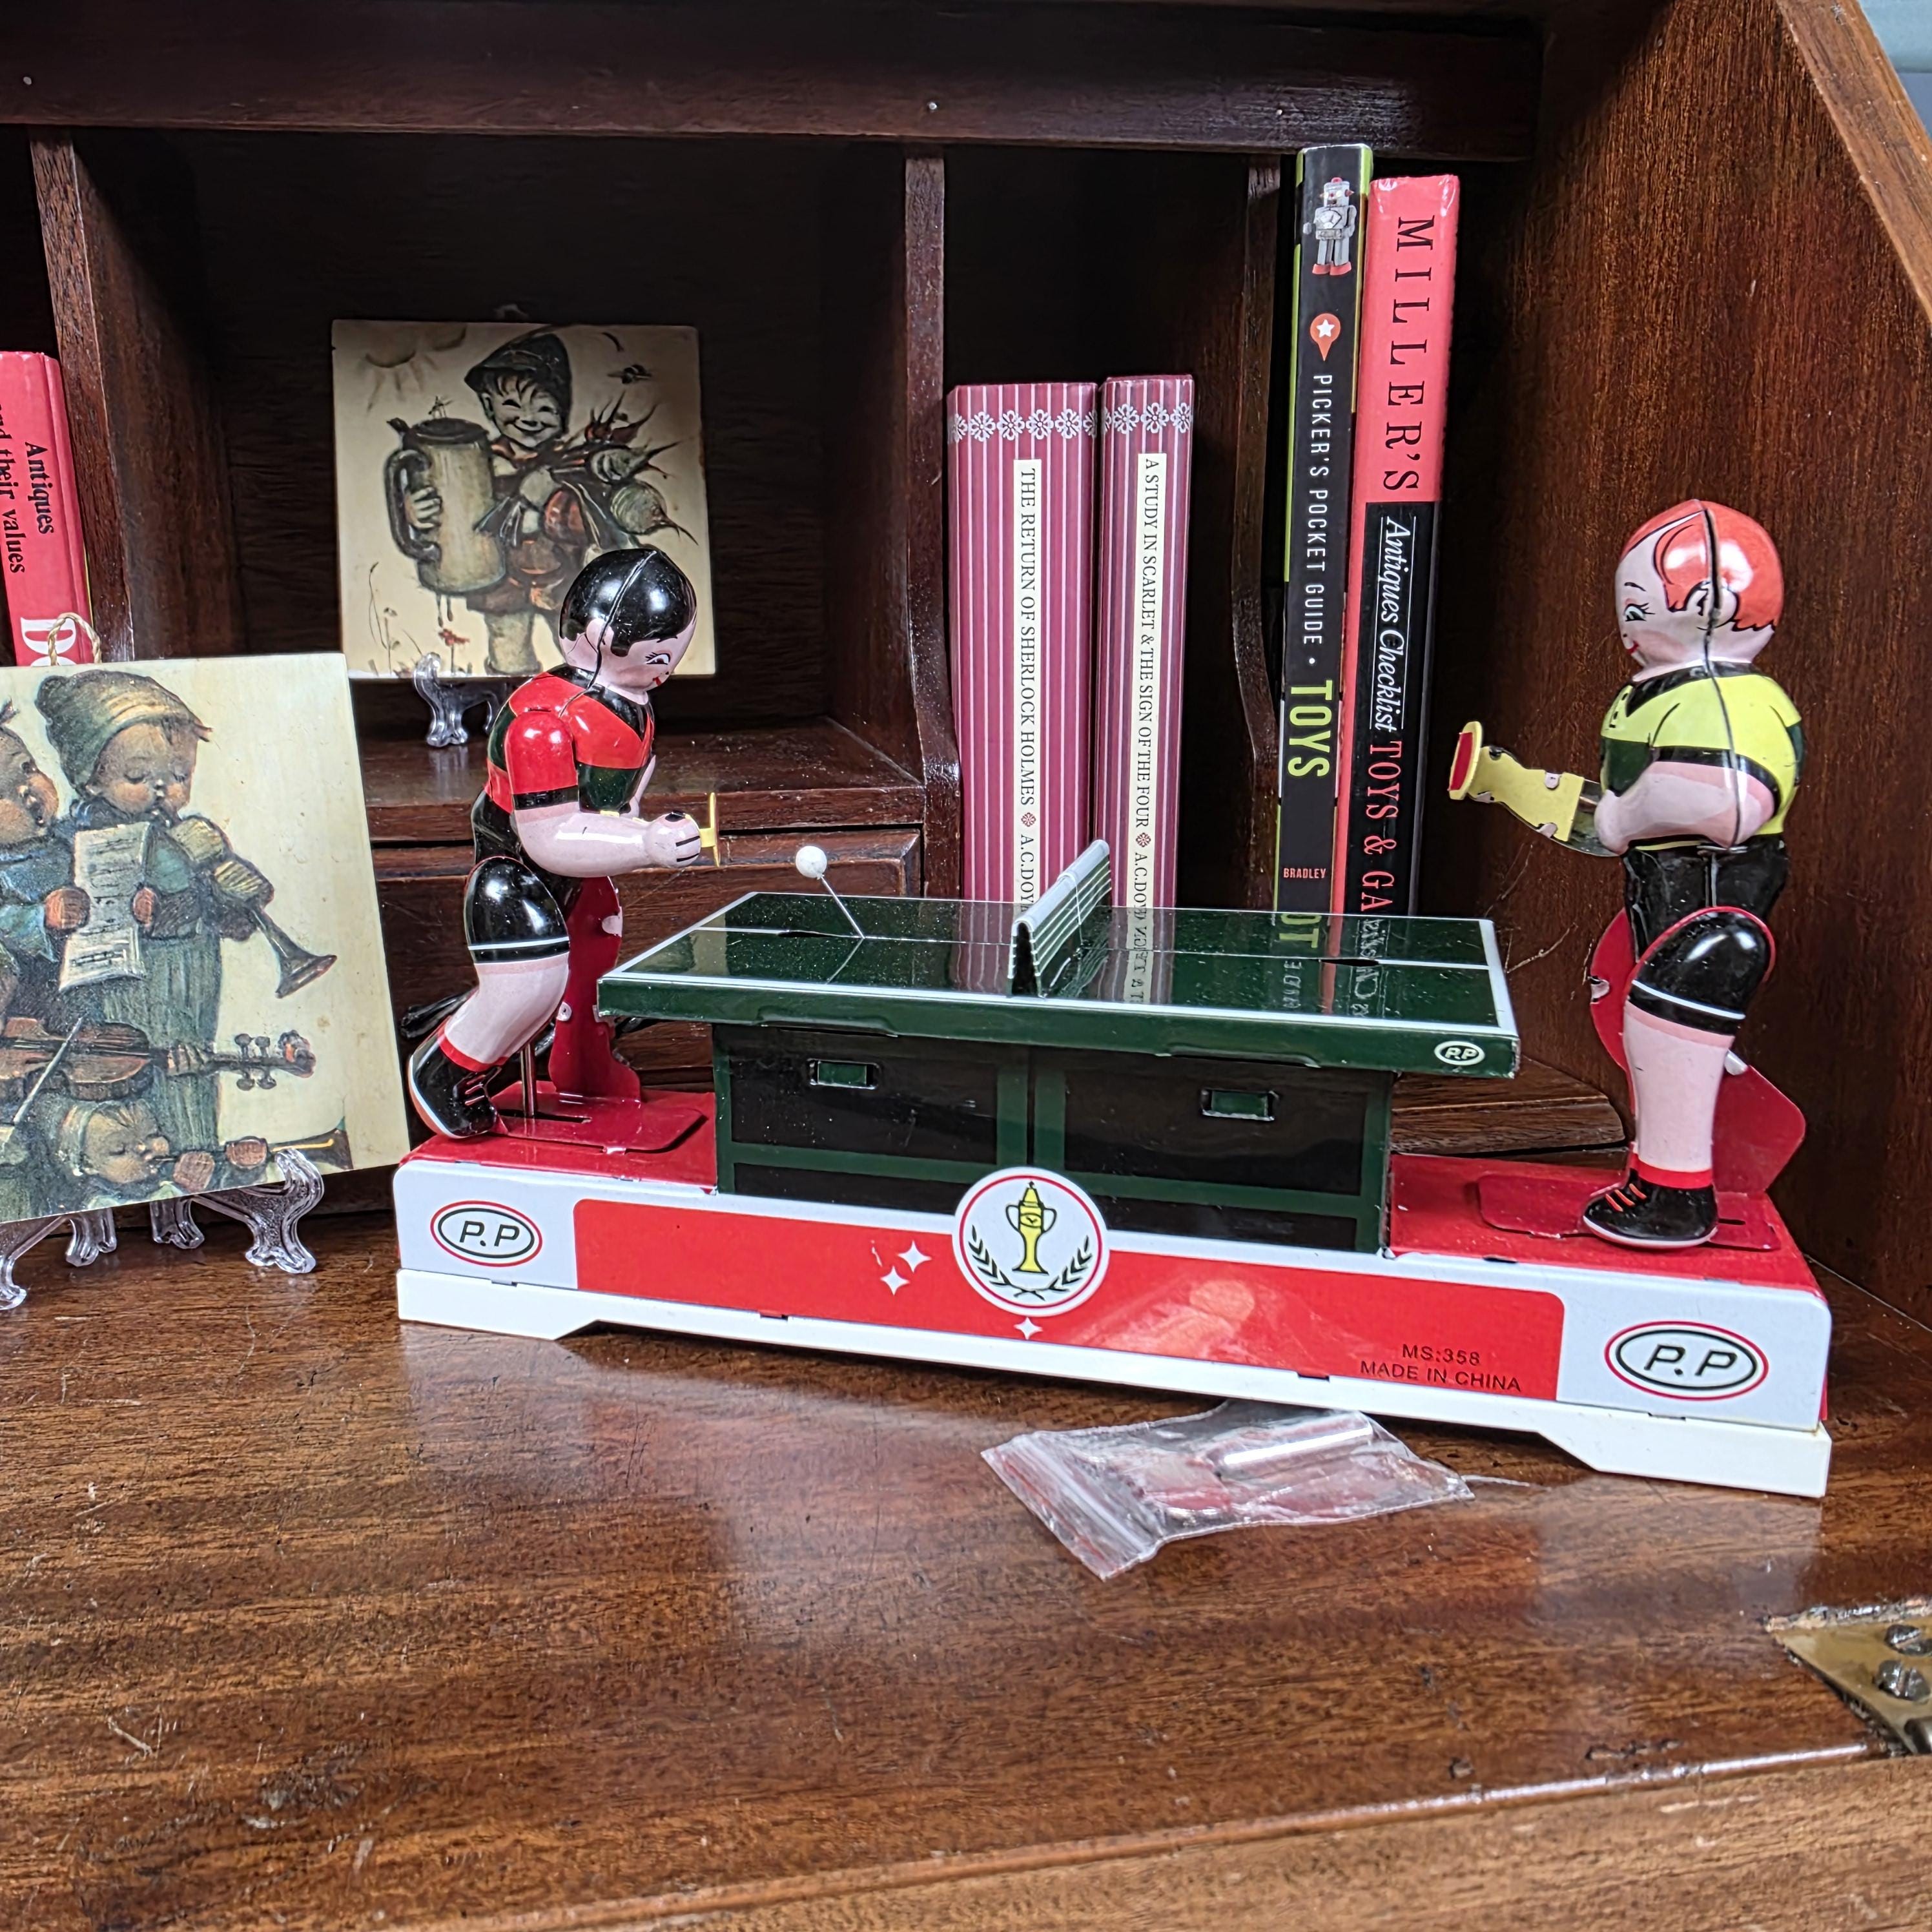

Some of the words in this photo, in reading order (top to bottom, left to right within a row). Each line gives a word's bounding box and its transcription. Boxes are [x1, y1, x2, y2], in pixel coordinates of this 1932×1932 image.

[1382, 214, 1435, 491] MILLER'S
[1310, 375, 1333, 477] PICKER'S
[0, 449, 19, 500] their
[1146, 458, 1159, 469] A
[25, 441, 54, 535] Antiques
[1021, 468, 1036, 508] THE
[1144, 475, 1159, 529] STUDY
[1, 508, 26, 573] values
[1020, 513, 1036, 591] RETURN
[1144, 534, 1157, 551] IN
[1306, 489, 1328, 572] POCKET
[1141, 555, 1157, 630] SCARLET
[1377, 515, 1411, 624] Antiques
[1020, 596, 1036, 621] OF
[1303, 583, 1324, 645] GUIDE
[1141, 634, 1155, 645] &
[1020, 626, 1035, 726] SHERLOCK
[1140, 646, 1154, 681] THE
[1375, 629, 1405, 733] Checklist
[1138, 685, 1153, 722] SIGN
[1138, 726, 1152, 748] OF
[1287, 679, 1333, 777] TOYS
[1020, 731, 1035, 806] HOLMES
[1136, 748, 1151, 782] THE
[1366, 741, 1403, 819] TOYS
[1135, 786, 1151, 828] FOUR
[1363, 835, 1397, 855] &
[1283, 867, 1326, 879] BRADLEY
[459, 1220, 520, 1247] P.P
[1360, 1360, 1419, 1380] MADE
[1426, 1367, 1448, 1384] IN
[1454, 1371, 1521, 1392] CHINA
[1402, 1343, 1480, 1366] MS:358
[1643, 1344, 1738, 1377] P.P
